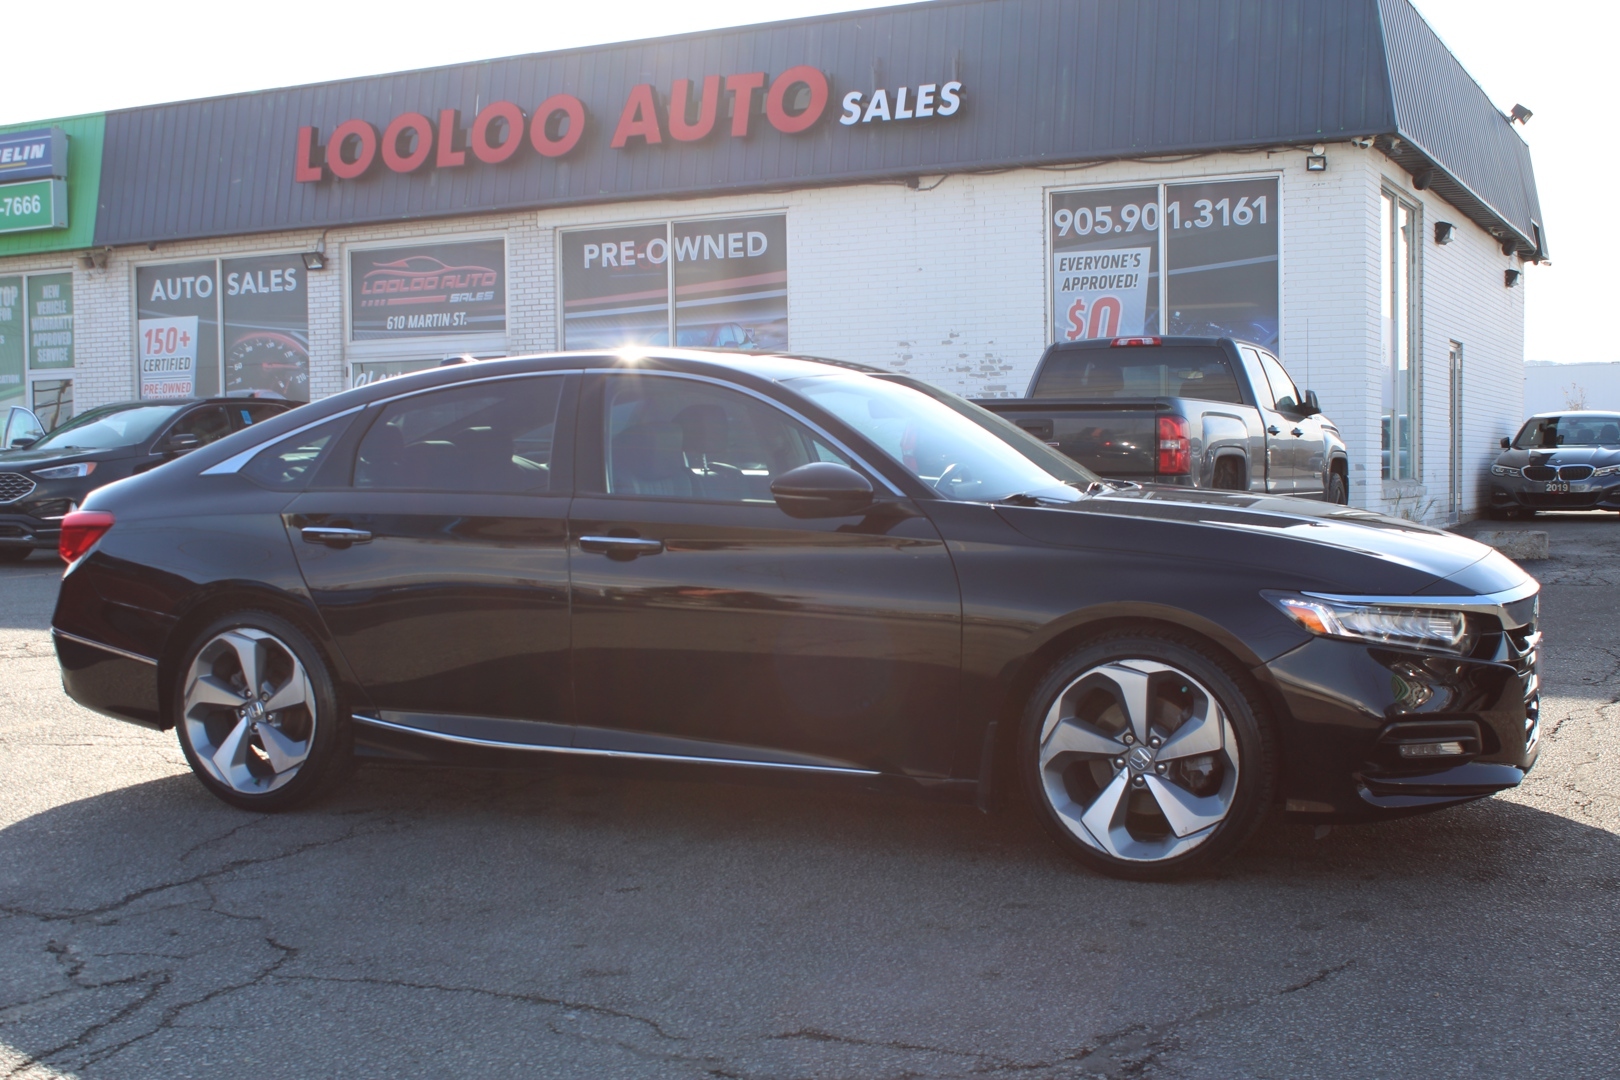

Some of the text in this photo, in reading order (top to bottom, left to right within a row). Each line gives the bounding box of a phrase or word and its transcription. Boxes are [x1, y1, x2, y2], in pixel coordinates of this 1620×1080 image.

[295, 65, 962, 183] LOOLOO AUTO SALES
[0, 143, 45, 163] ELIN
[1054, 195, 1267, 237] 905.901.3161
[583, 231, 768, 269] PRE-OWNED
[1059, 253, 1141, 272] EVERYONE'S
[42, 284, 60, 299] NEW
[150, 268, 297, 302] AUTO SALES
[361, 272, 497, 295] LOOLOO AUTO
[1062, 273, 1139, 292] APPROVED!
[450, 291, 494, 303] SALES
[36, 300, 67, 315] VEHICLE
[31, 316, 73, 331] WARRANTY
[386, 312, 467, 330] 610 MARTIN ST.
[33, 332, 72, 347] APPROVED
[144, 326, 191, 355] 150+
[37, 348, 68, 363] SERVICE
[143, 357, 191, 372] CERTIFIED
[143, 382, 192, 395] PRE-OWNED
[1546, 483, 1569, 492] 2019
